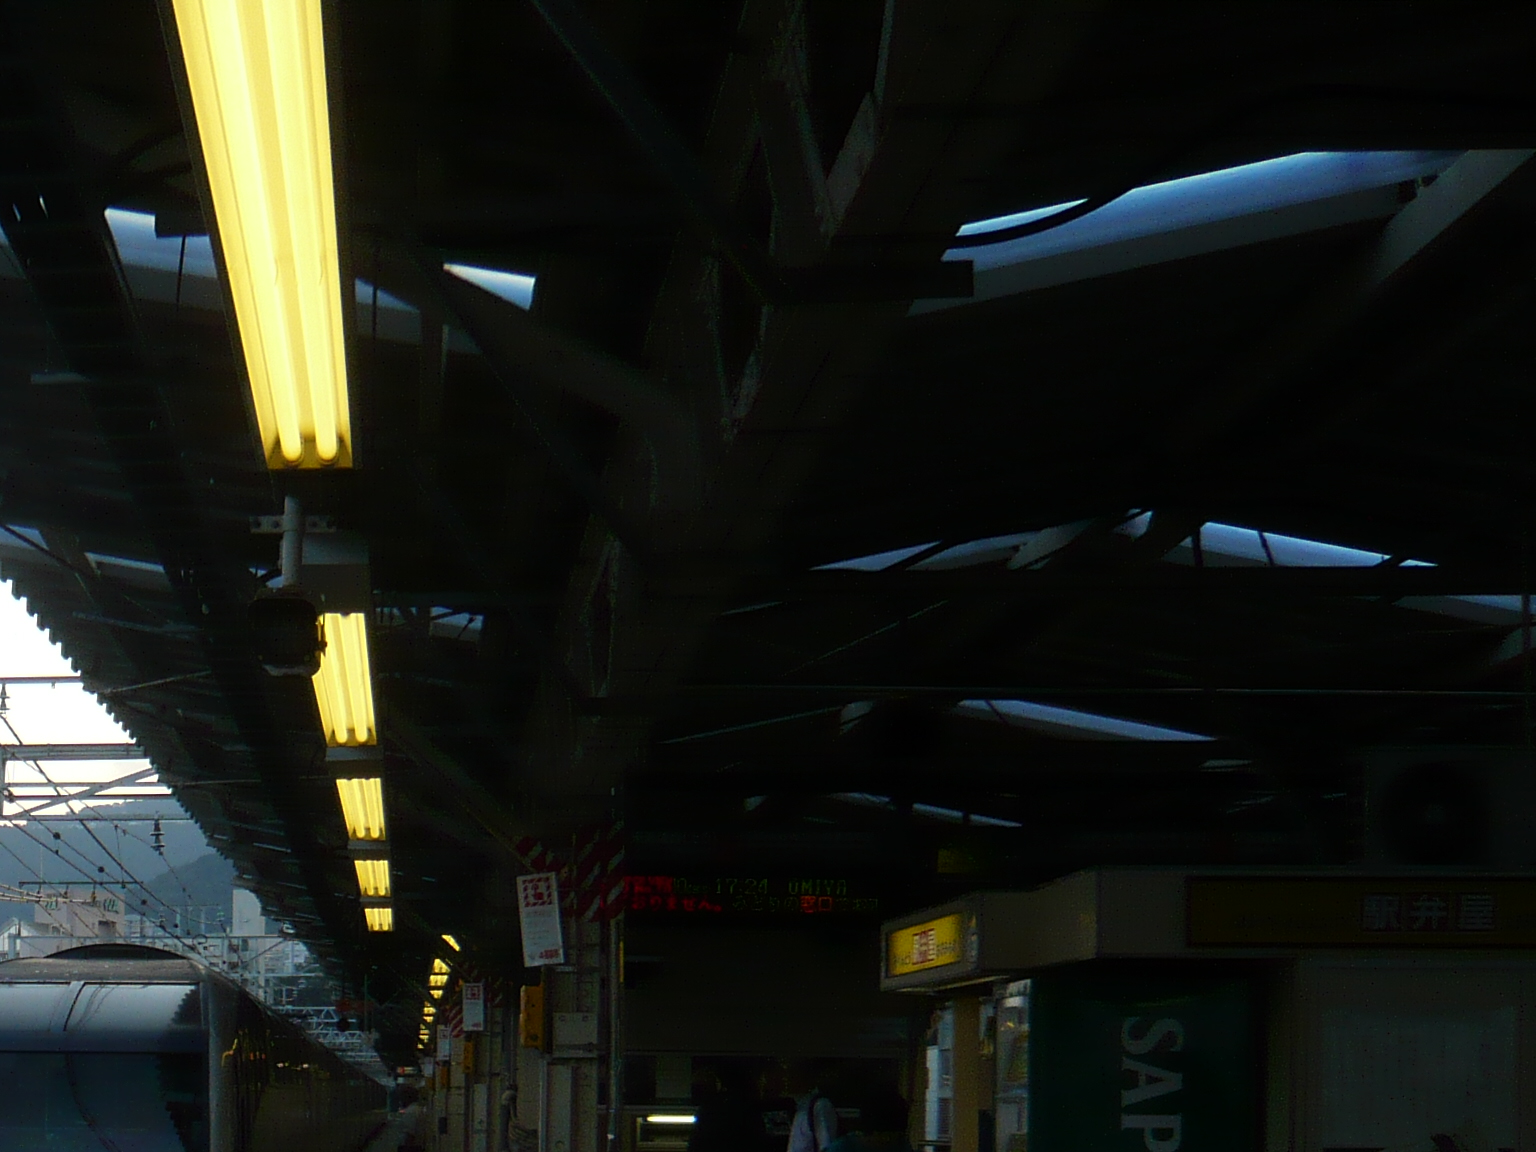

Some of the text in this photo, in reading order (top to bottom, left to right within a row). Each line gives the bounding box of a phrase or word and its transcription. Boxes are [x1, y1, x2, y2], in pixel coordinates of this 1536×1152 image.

[715, 877, 767, 894] 17:24
[788, 877, 848, 895] OMIYA
[1363, 892, 1497, 932] 駅弁屋
